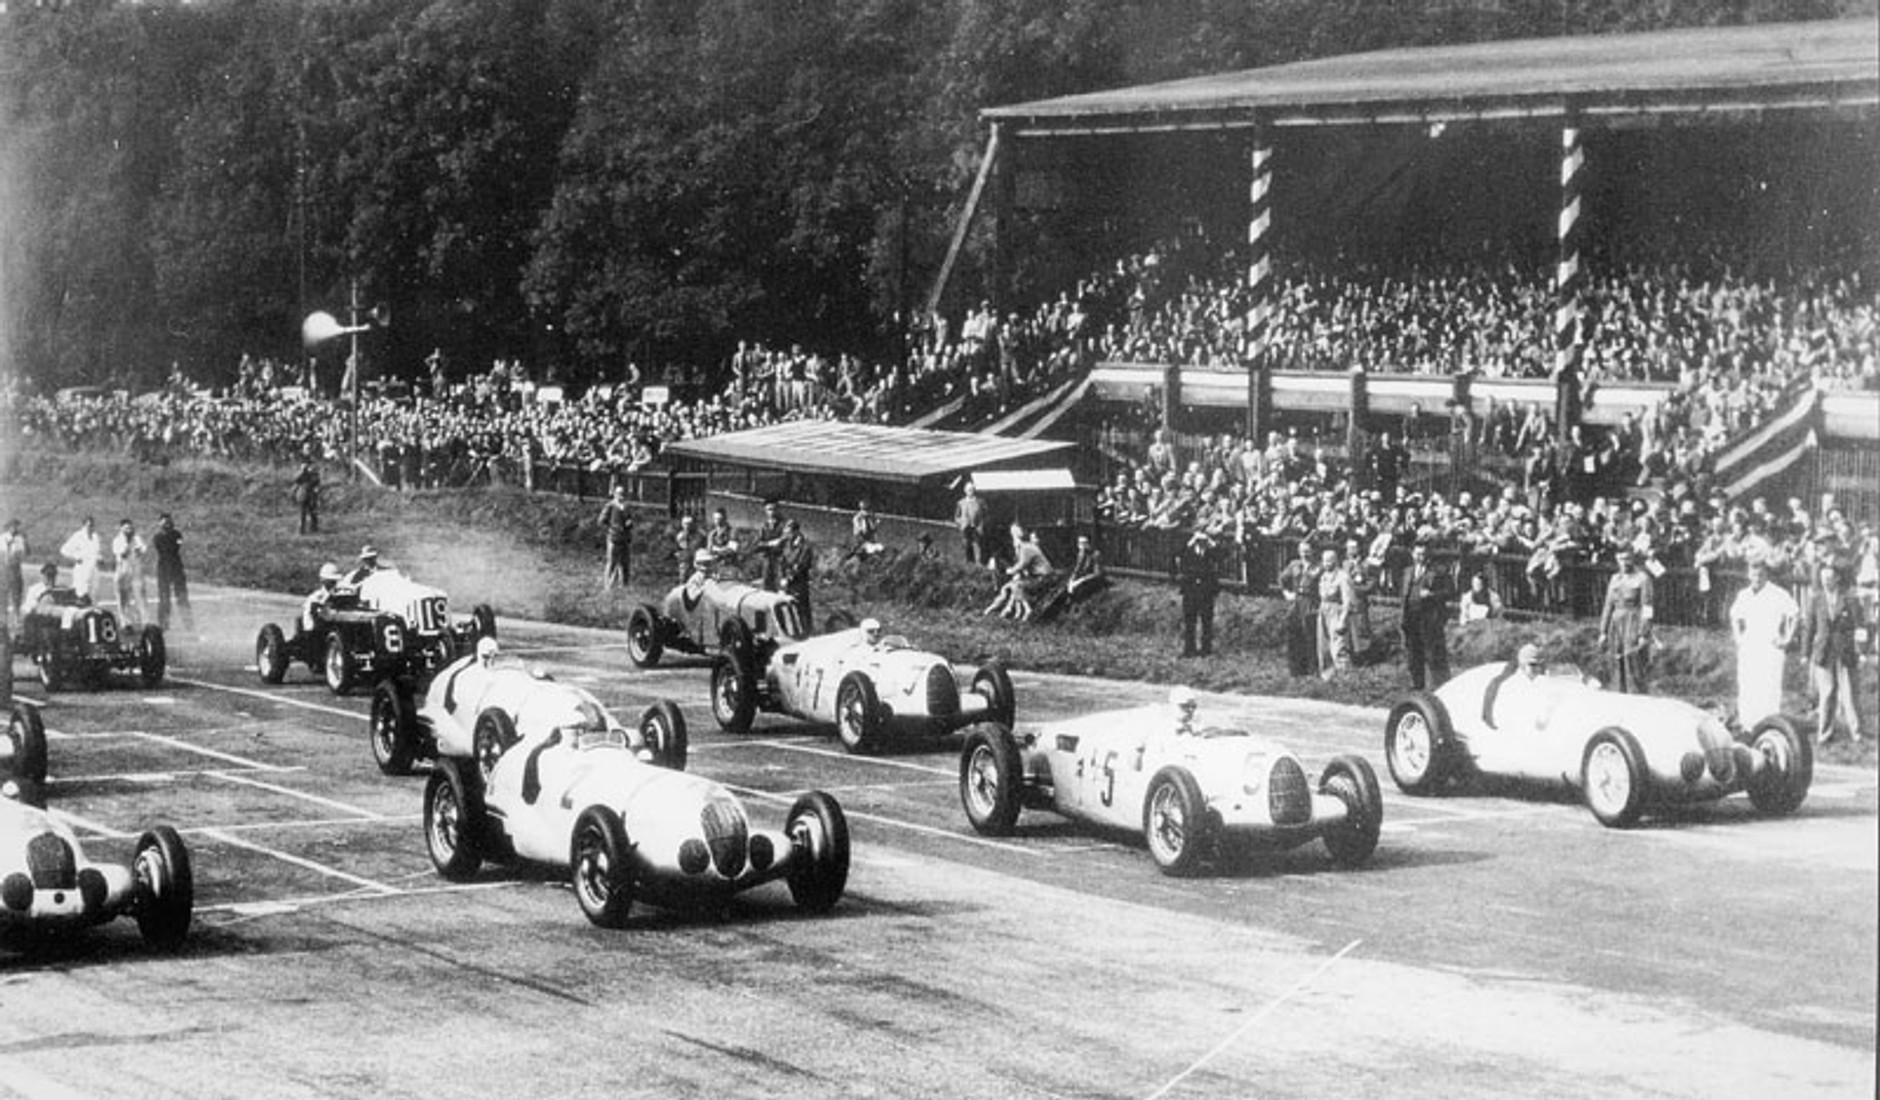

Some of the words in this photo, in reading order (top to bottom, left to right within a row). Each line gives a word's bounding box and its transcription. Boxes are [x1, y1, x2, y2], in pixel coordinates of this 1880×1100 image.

[425, 600, 450, 629] 19
[87, 617, 117, 643] 18
[383, 625, 404, 653] 8
[1101, 750, 1119, 808] 5
